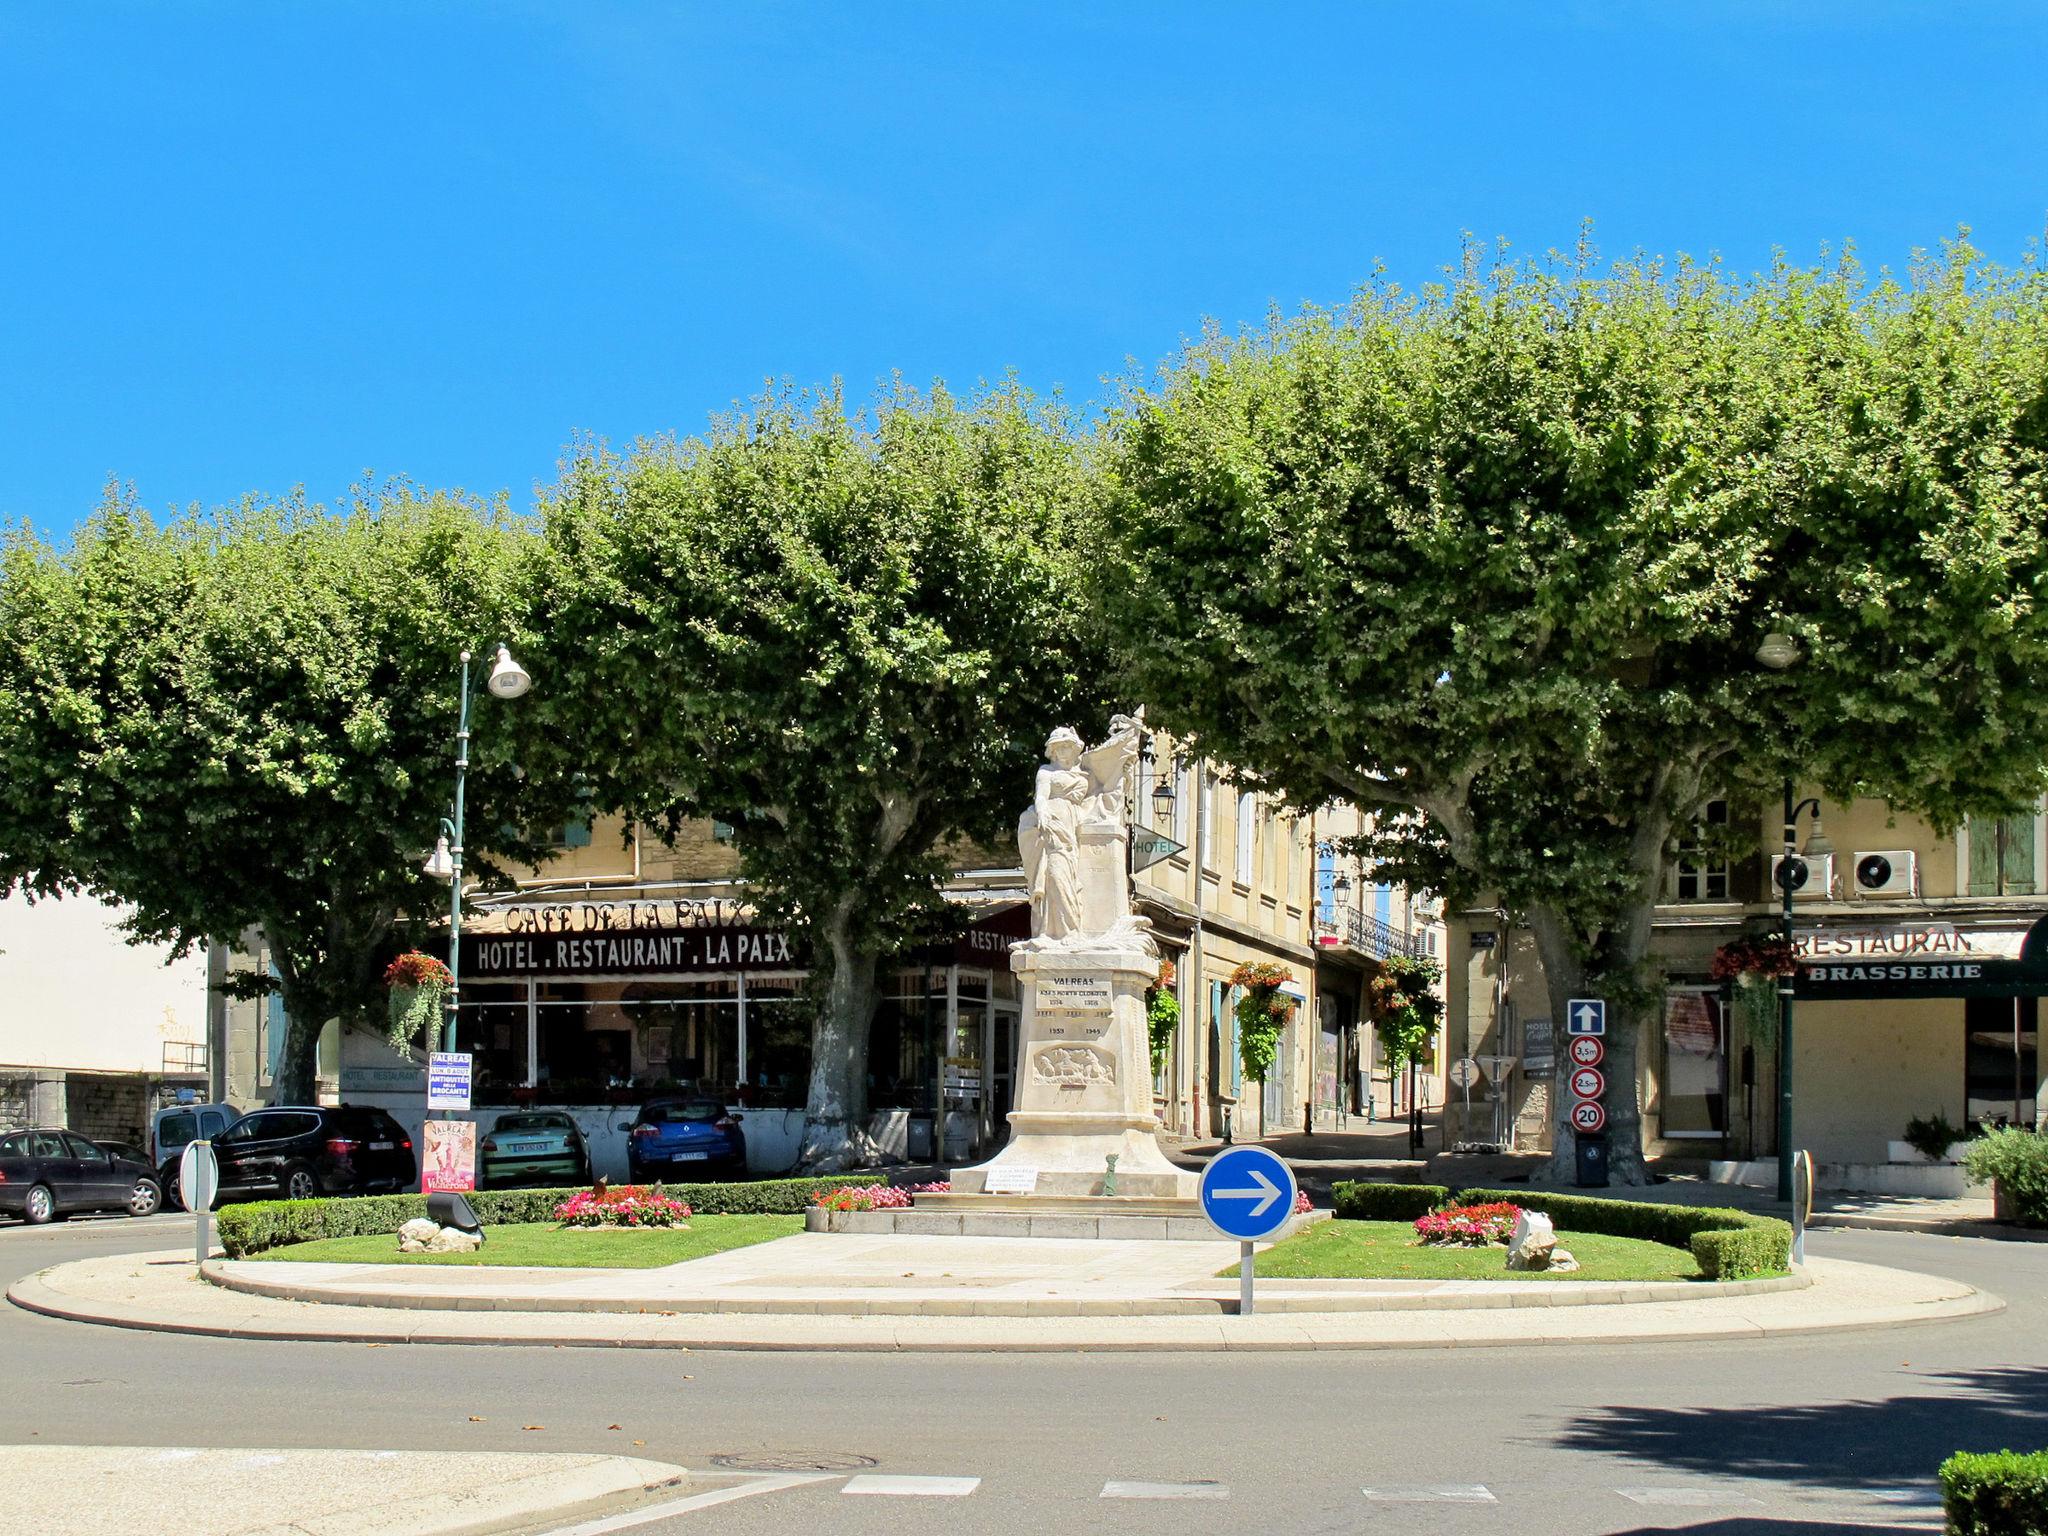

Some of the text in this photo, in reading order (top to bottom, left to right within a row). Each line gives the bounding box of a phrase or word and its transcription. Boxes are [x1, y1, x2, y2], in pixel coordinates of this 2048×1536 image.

[1136, 841, 1174, 853] HOTEL
[478, 941, 538, 969] HOTEL
[557, 937, 685, 968] RESTAURANT
[706, 935, 731, 964] LA
[738, 933, 790, 963] PAIX
[1808, 964, 1982, 981] BRASSERIE
[1053, 977, 1094, 986] VALREAS
[431, 1055, 469, 1063] VALREAS
[1579, 1109, 1598, 1123] 20
